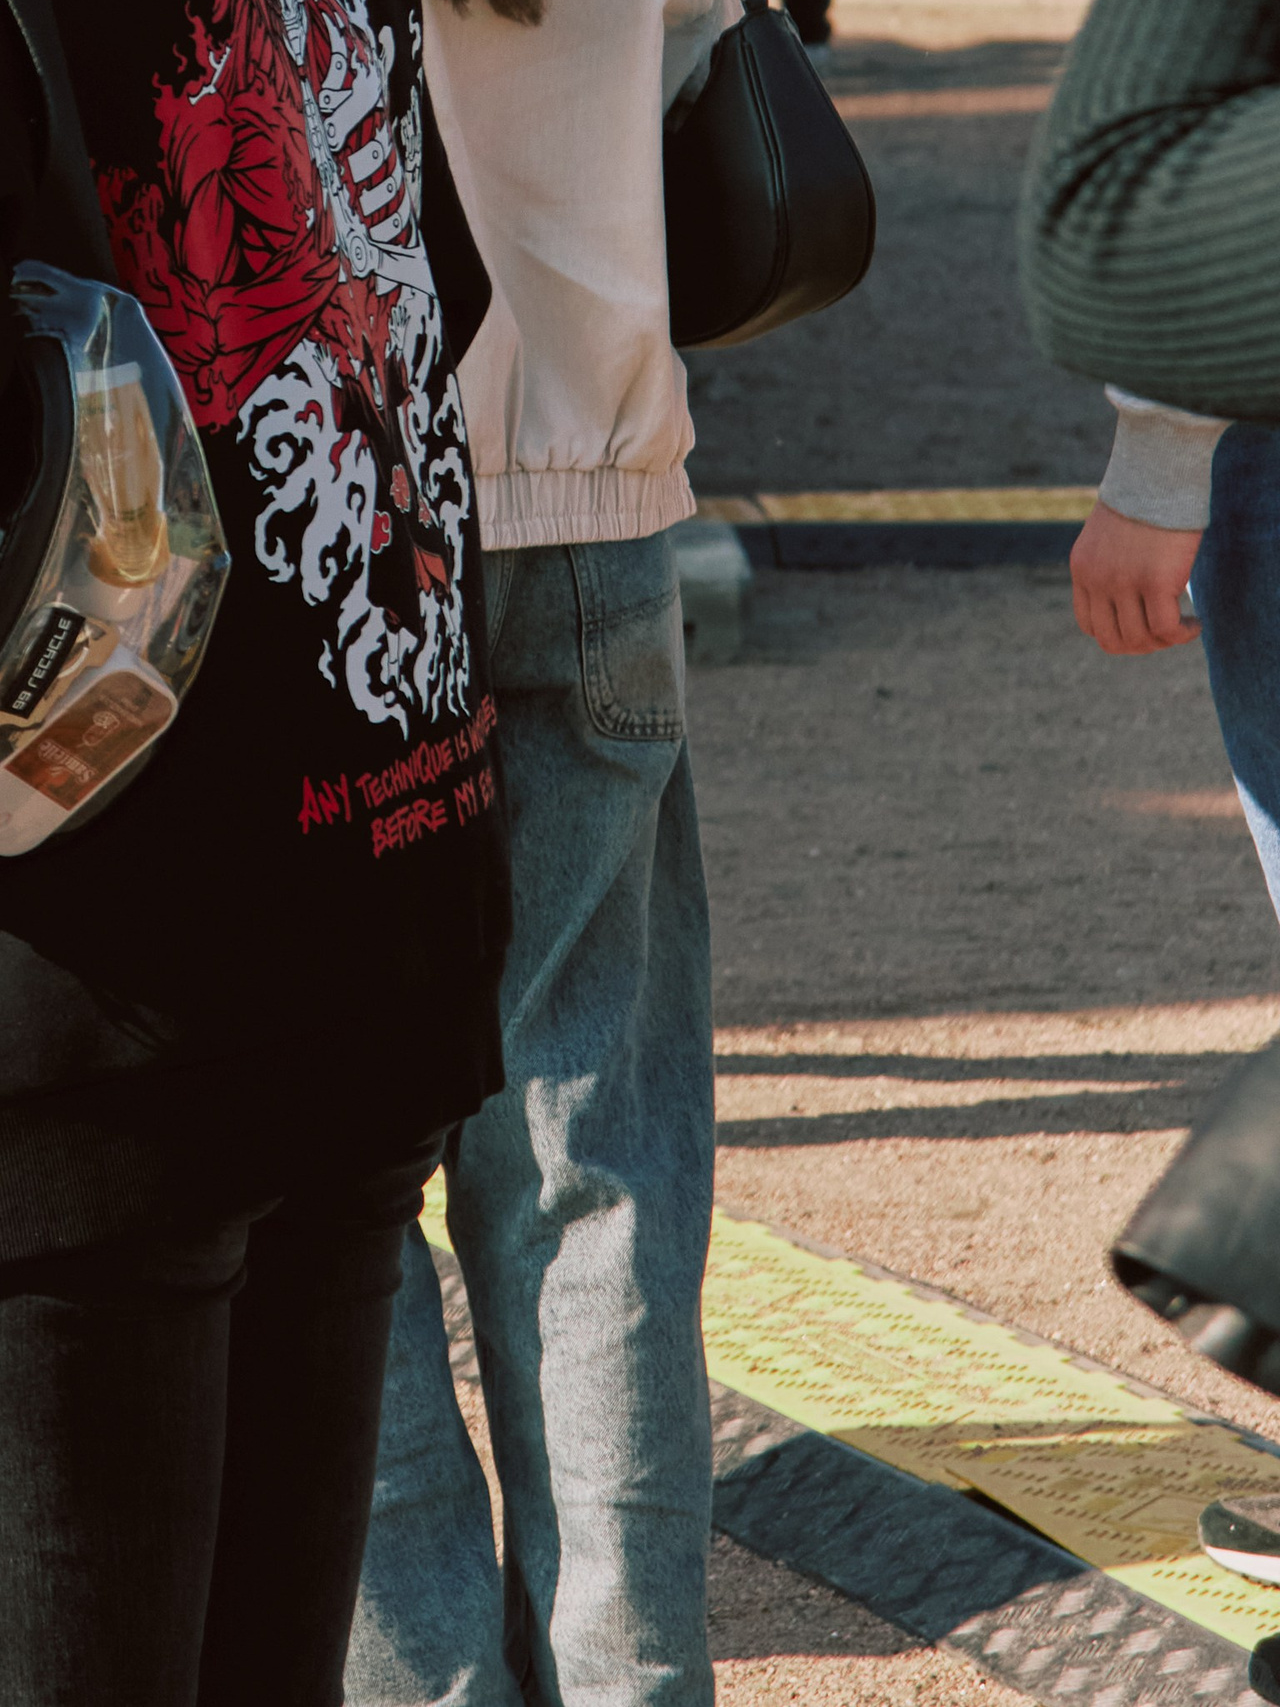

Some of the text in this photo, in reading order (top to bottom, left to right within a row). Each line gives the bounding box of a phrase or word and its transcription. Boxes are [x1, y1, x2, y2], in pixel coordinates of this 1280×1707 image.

[11, 617, 72, 711] 99 RECYCLE
[298, 773, 352, 835] ANY
[355, 739, 454, 809] TECHNIQUE
[454, 734, 470, 763] IS
[370, 798, 448, 859] BEFORE
[453, 776, 478, 827] MY
